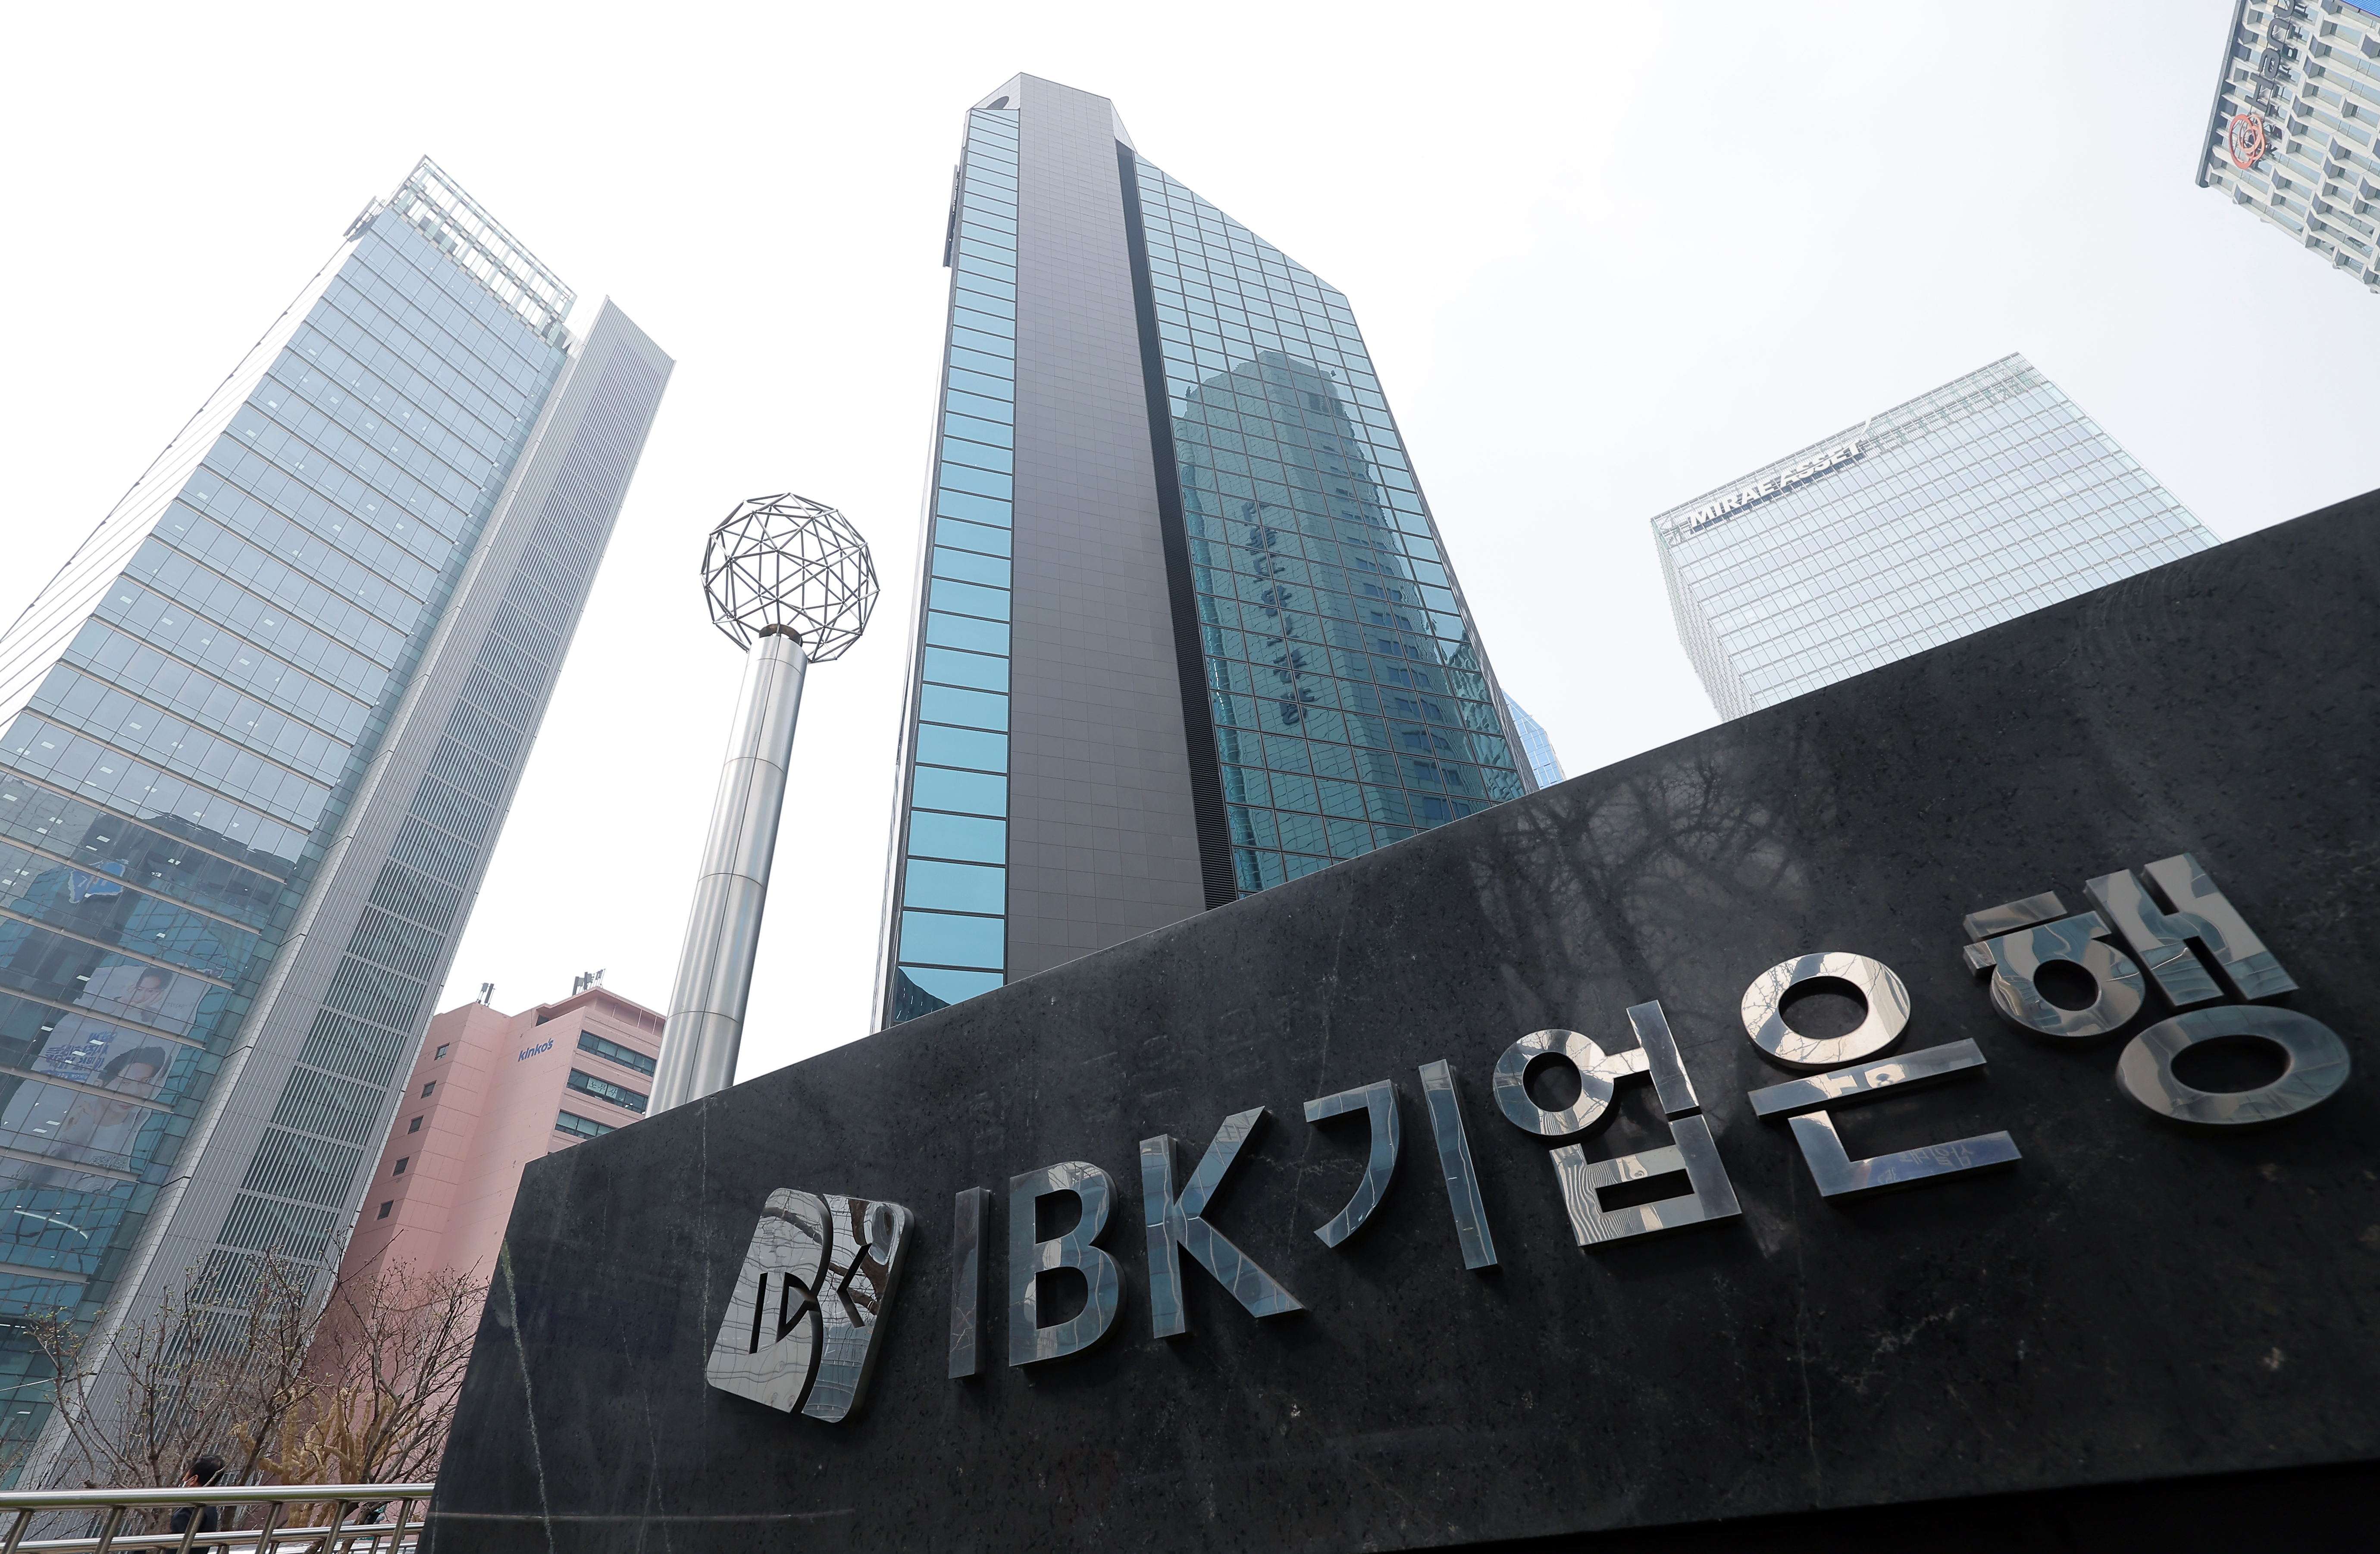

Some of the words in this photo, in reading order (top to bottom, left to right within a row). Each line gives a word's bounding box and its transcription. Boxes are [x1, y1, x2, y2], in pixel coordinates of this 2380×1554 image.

[1688, 478, 1775, 528] MIRAE
[1780, 440, 1861, 488] ASSET
[518, 1038, 554, 1062] kinko's
[588, 1081, 617, 1096] 노무사
